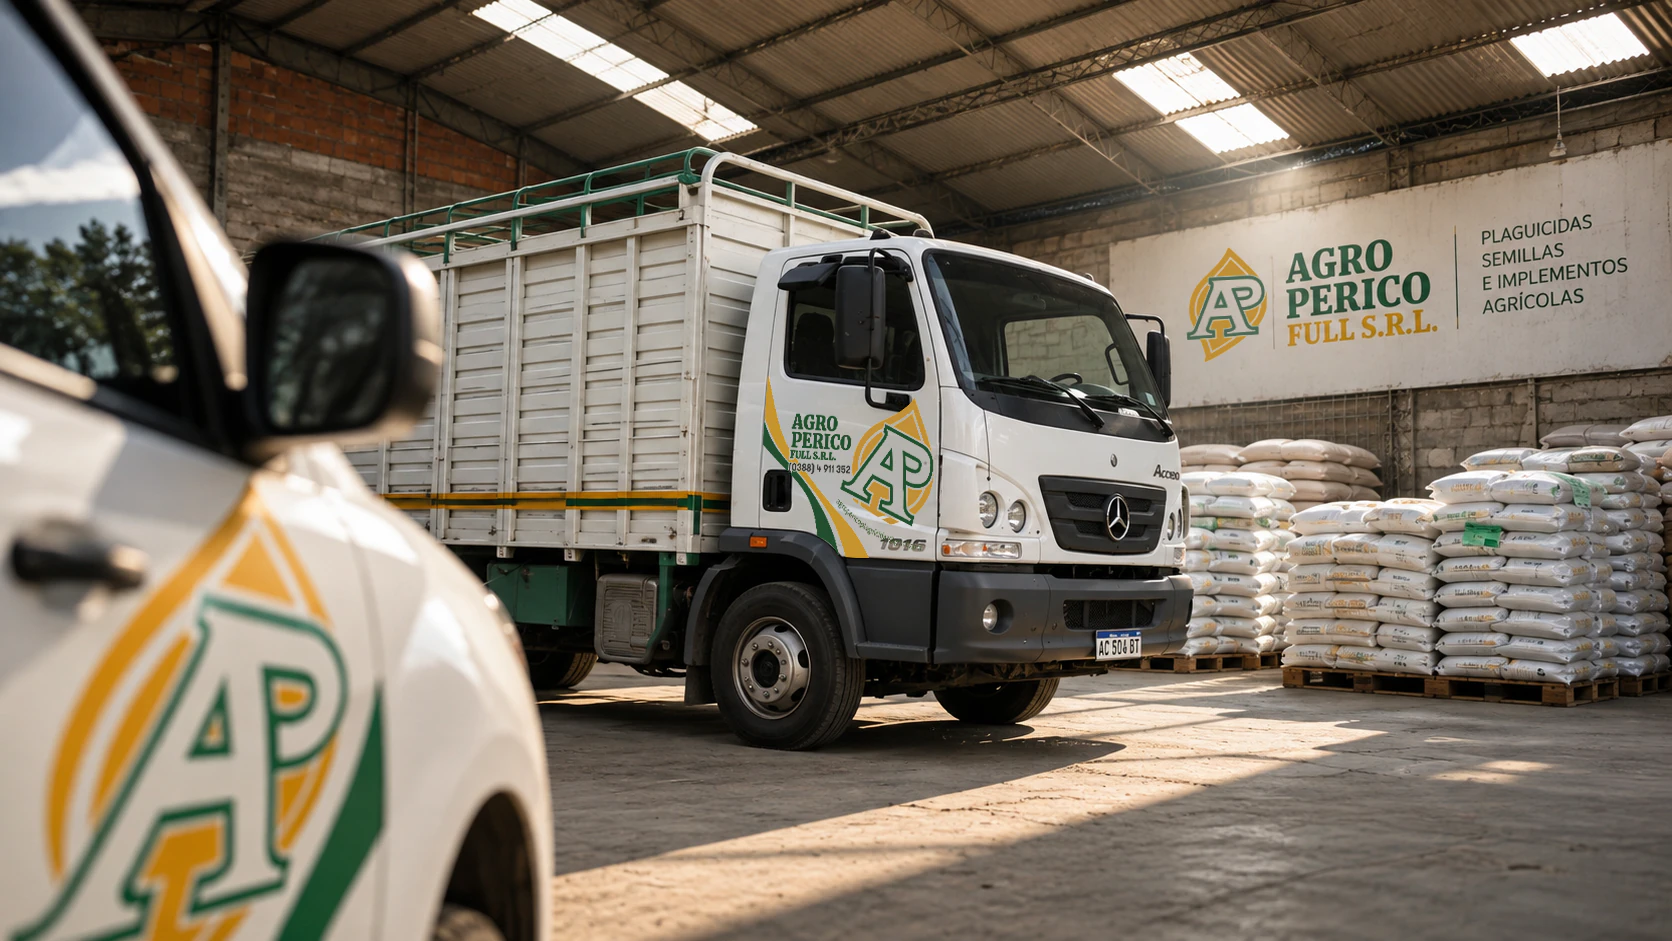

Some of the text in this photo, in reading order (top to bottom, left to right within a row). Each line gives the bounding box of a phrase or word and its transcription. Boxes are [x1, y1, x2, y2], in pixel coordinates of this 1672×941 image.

[1481, 214, 1593, 245] PLAGUICIDAS
[1285, 239, 1393, 284] AGRO
[1481, 242, 1565, 268] SEMILLAS
[1482, 257, 1628, 291] E IMPLEMENTOS
[1286, 271, 1431, 319] PERICO
[1482, 288, 1585, 315] AGRÍCOLAS
[1287, 309, 1438, 347] FULL S.R.L.
[791, 413, 839, 432] AGRO
[790, 431, 852, 451] PERICO
[789, 449, 837, 461] FULL S.R.L.
[789, 462, 815, 475] (0388)
[880, 538, 927, 552] 1016
[1098, 640, 1110, 656] AC
[1129, 638, 1140, 654] BT
